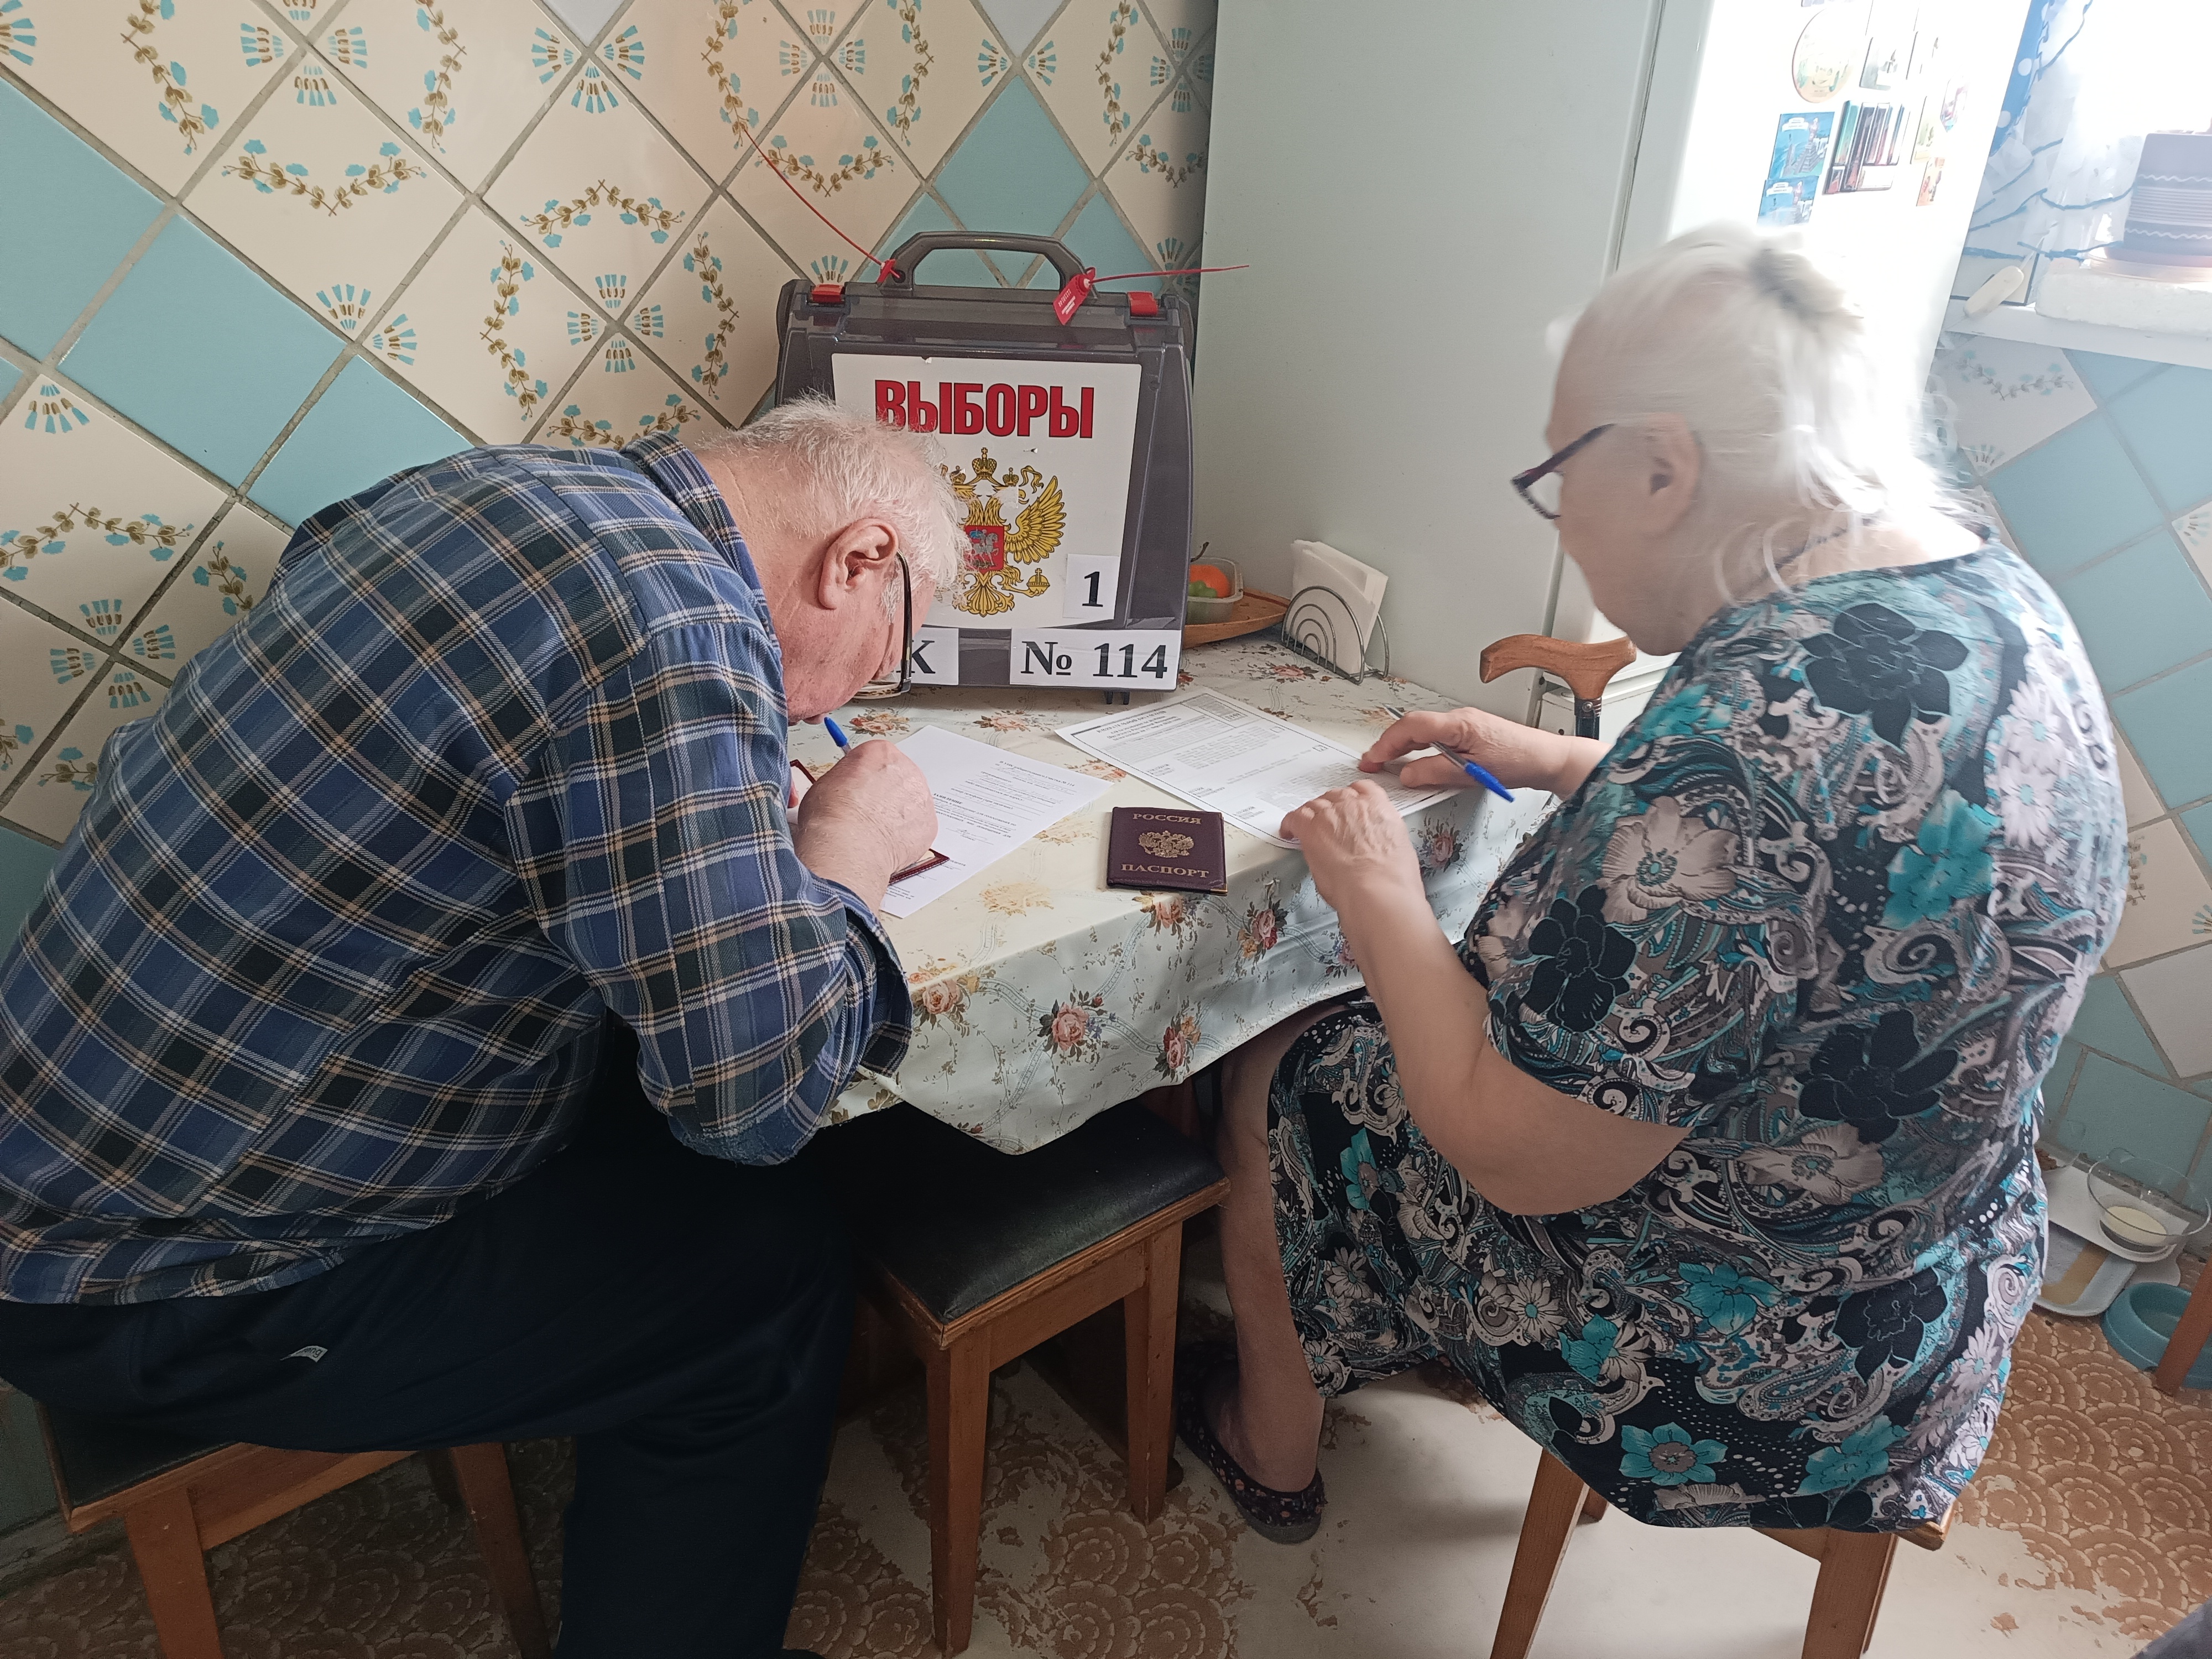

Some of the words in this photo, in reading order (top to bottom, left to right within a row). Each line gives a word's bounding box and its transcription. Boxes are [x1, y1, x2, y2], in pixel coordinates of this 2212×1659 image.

[875, 379, 1093, 438] ВЫБОРЫ
[1082, 571, 1104, 608] 1
[1021, 640, 1073, 676] №
[1092, 643, 1168, 679] 114
[1133, 813, 1202, 825] РОССИЯ
[1120, 863, 1210, 878] ПАСПОРТ
